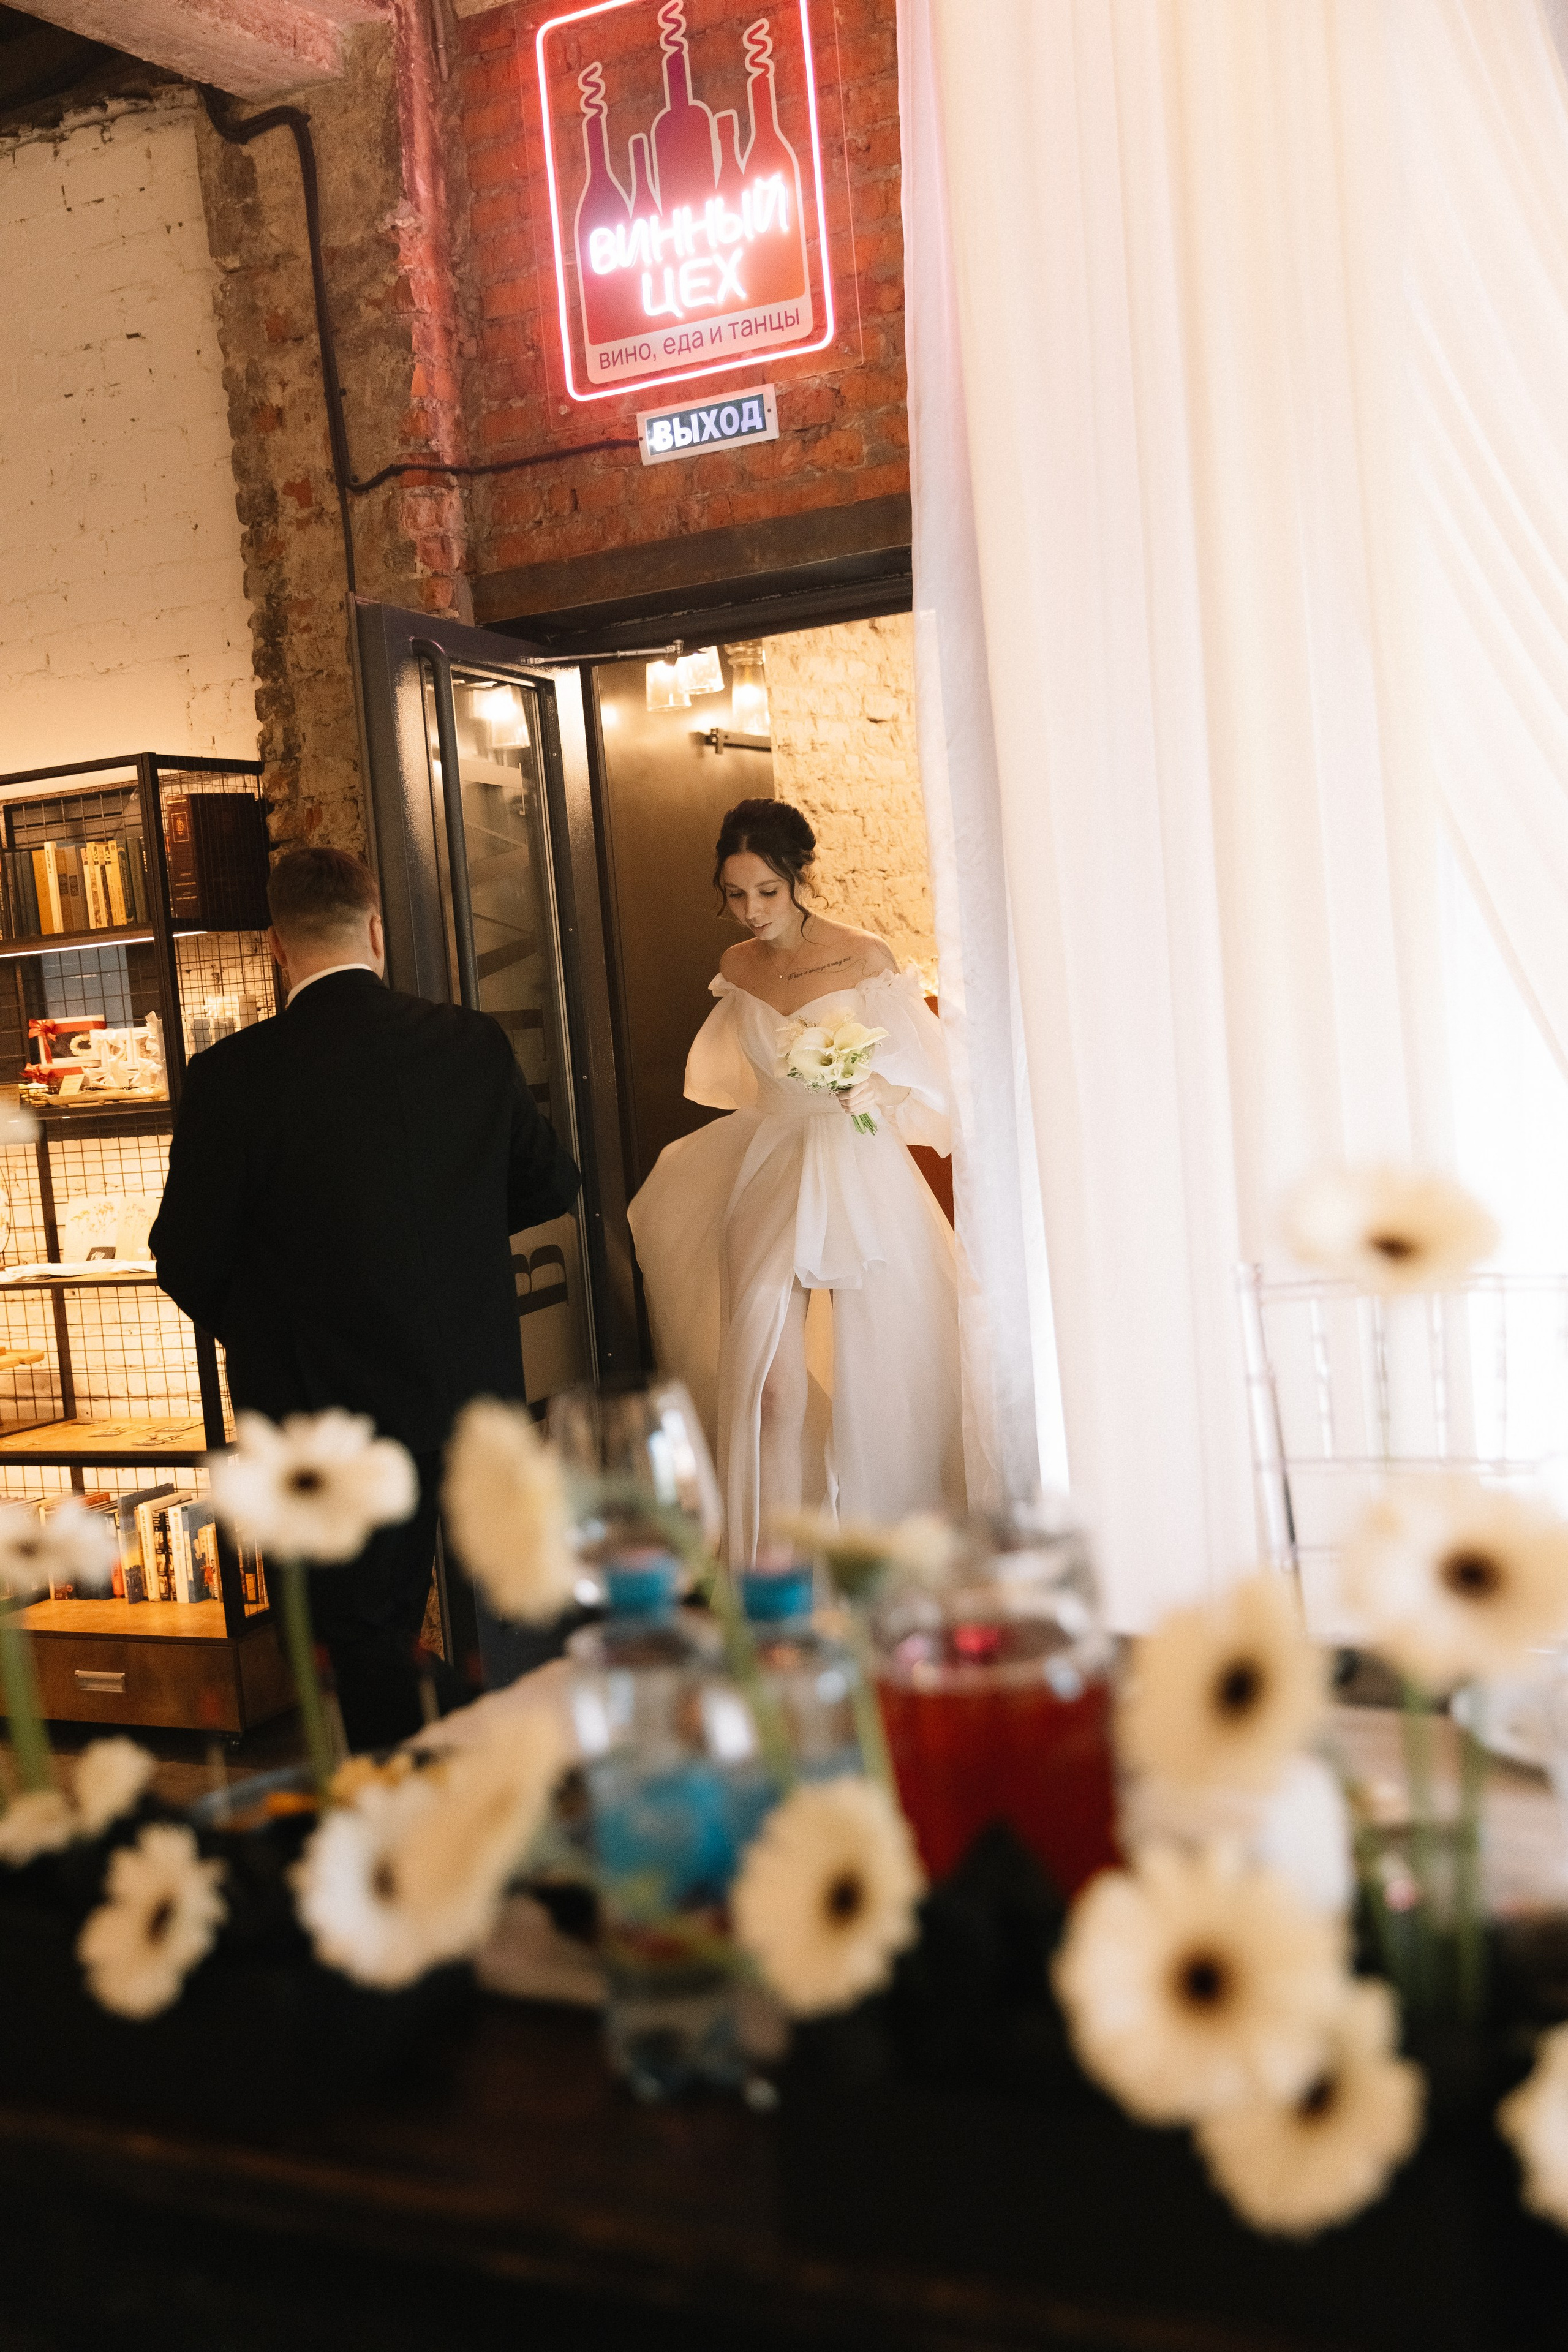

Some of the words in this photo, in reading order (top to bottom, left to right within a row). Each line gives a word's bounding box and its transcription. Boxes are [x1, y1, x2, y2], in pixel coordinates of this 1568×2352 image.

[589, 172, 789, 275] ВИННЫЙ
[641, 249, 747, 318] ЦЕХ
[600, 342, 656, 370] вино,
[663, 331, 704, 356] еда
[710, 325, 722, 344] и
[728, 308, 800, 339] танцы
[652, 400, 763, 452] ВЫХОД
